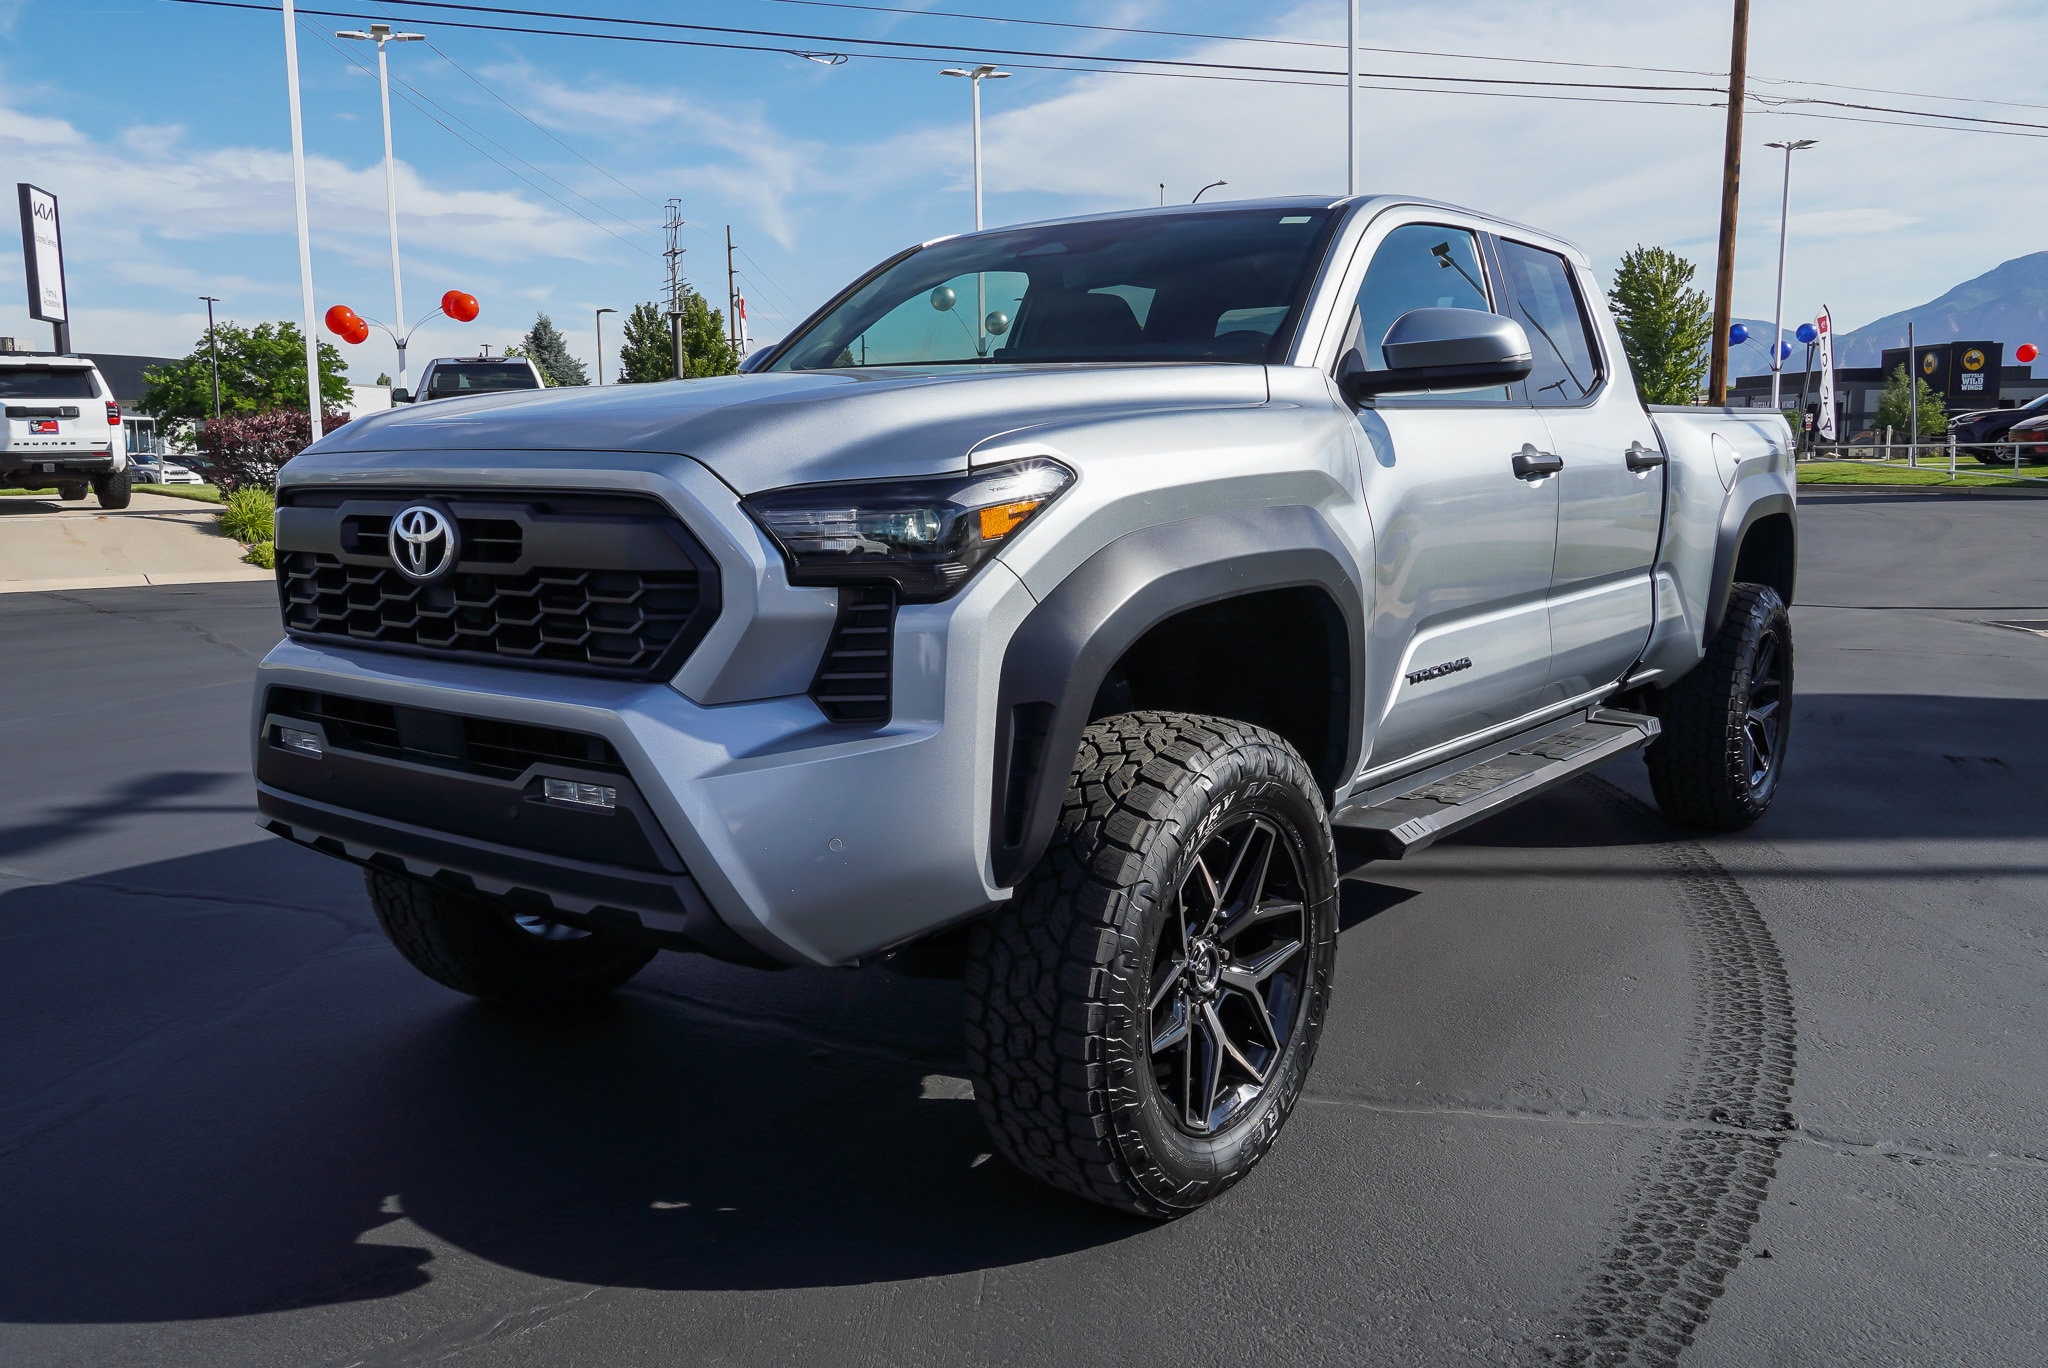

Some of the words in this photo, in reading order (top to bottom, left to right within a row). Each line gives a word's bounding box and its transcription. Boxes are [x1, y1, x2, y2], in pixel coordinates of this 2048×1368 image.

[1820, 335, 1833, 432] TOOTA
[1961, 377, 1984, 385] WILD
[1405, 656, 1473, 686] TACOMA
